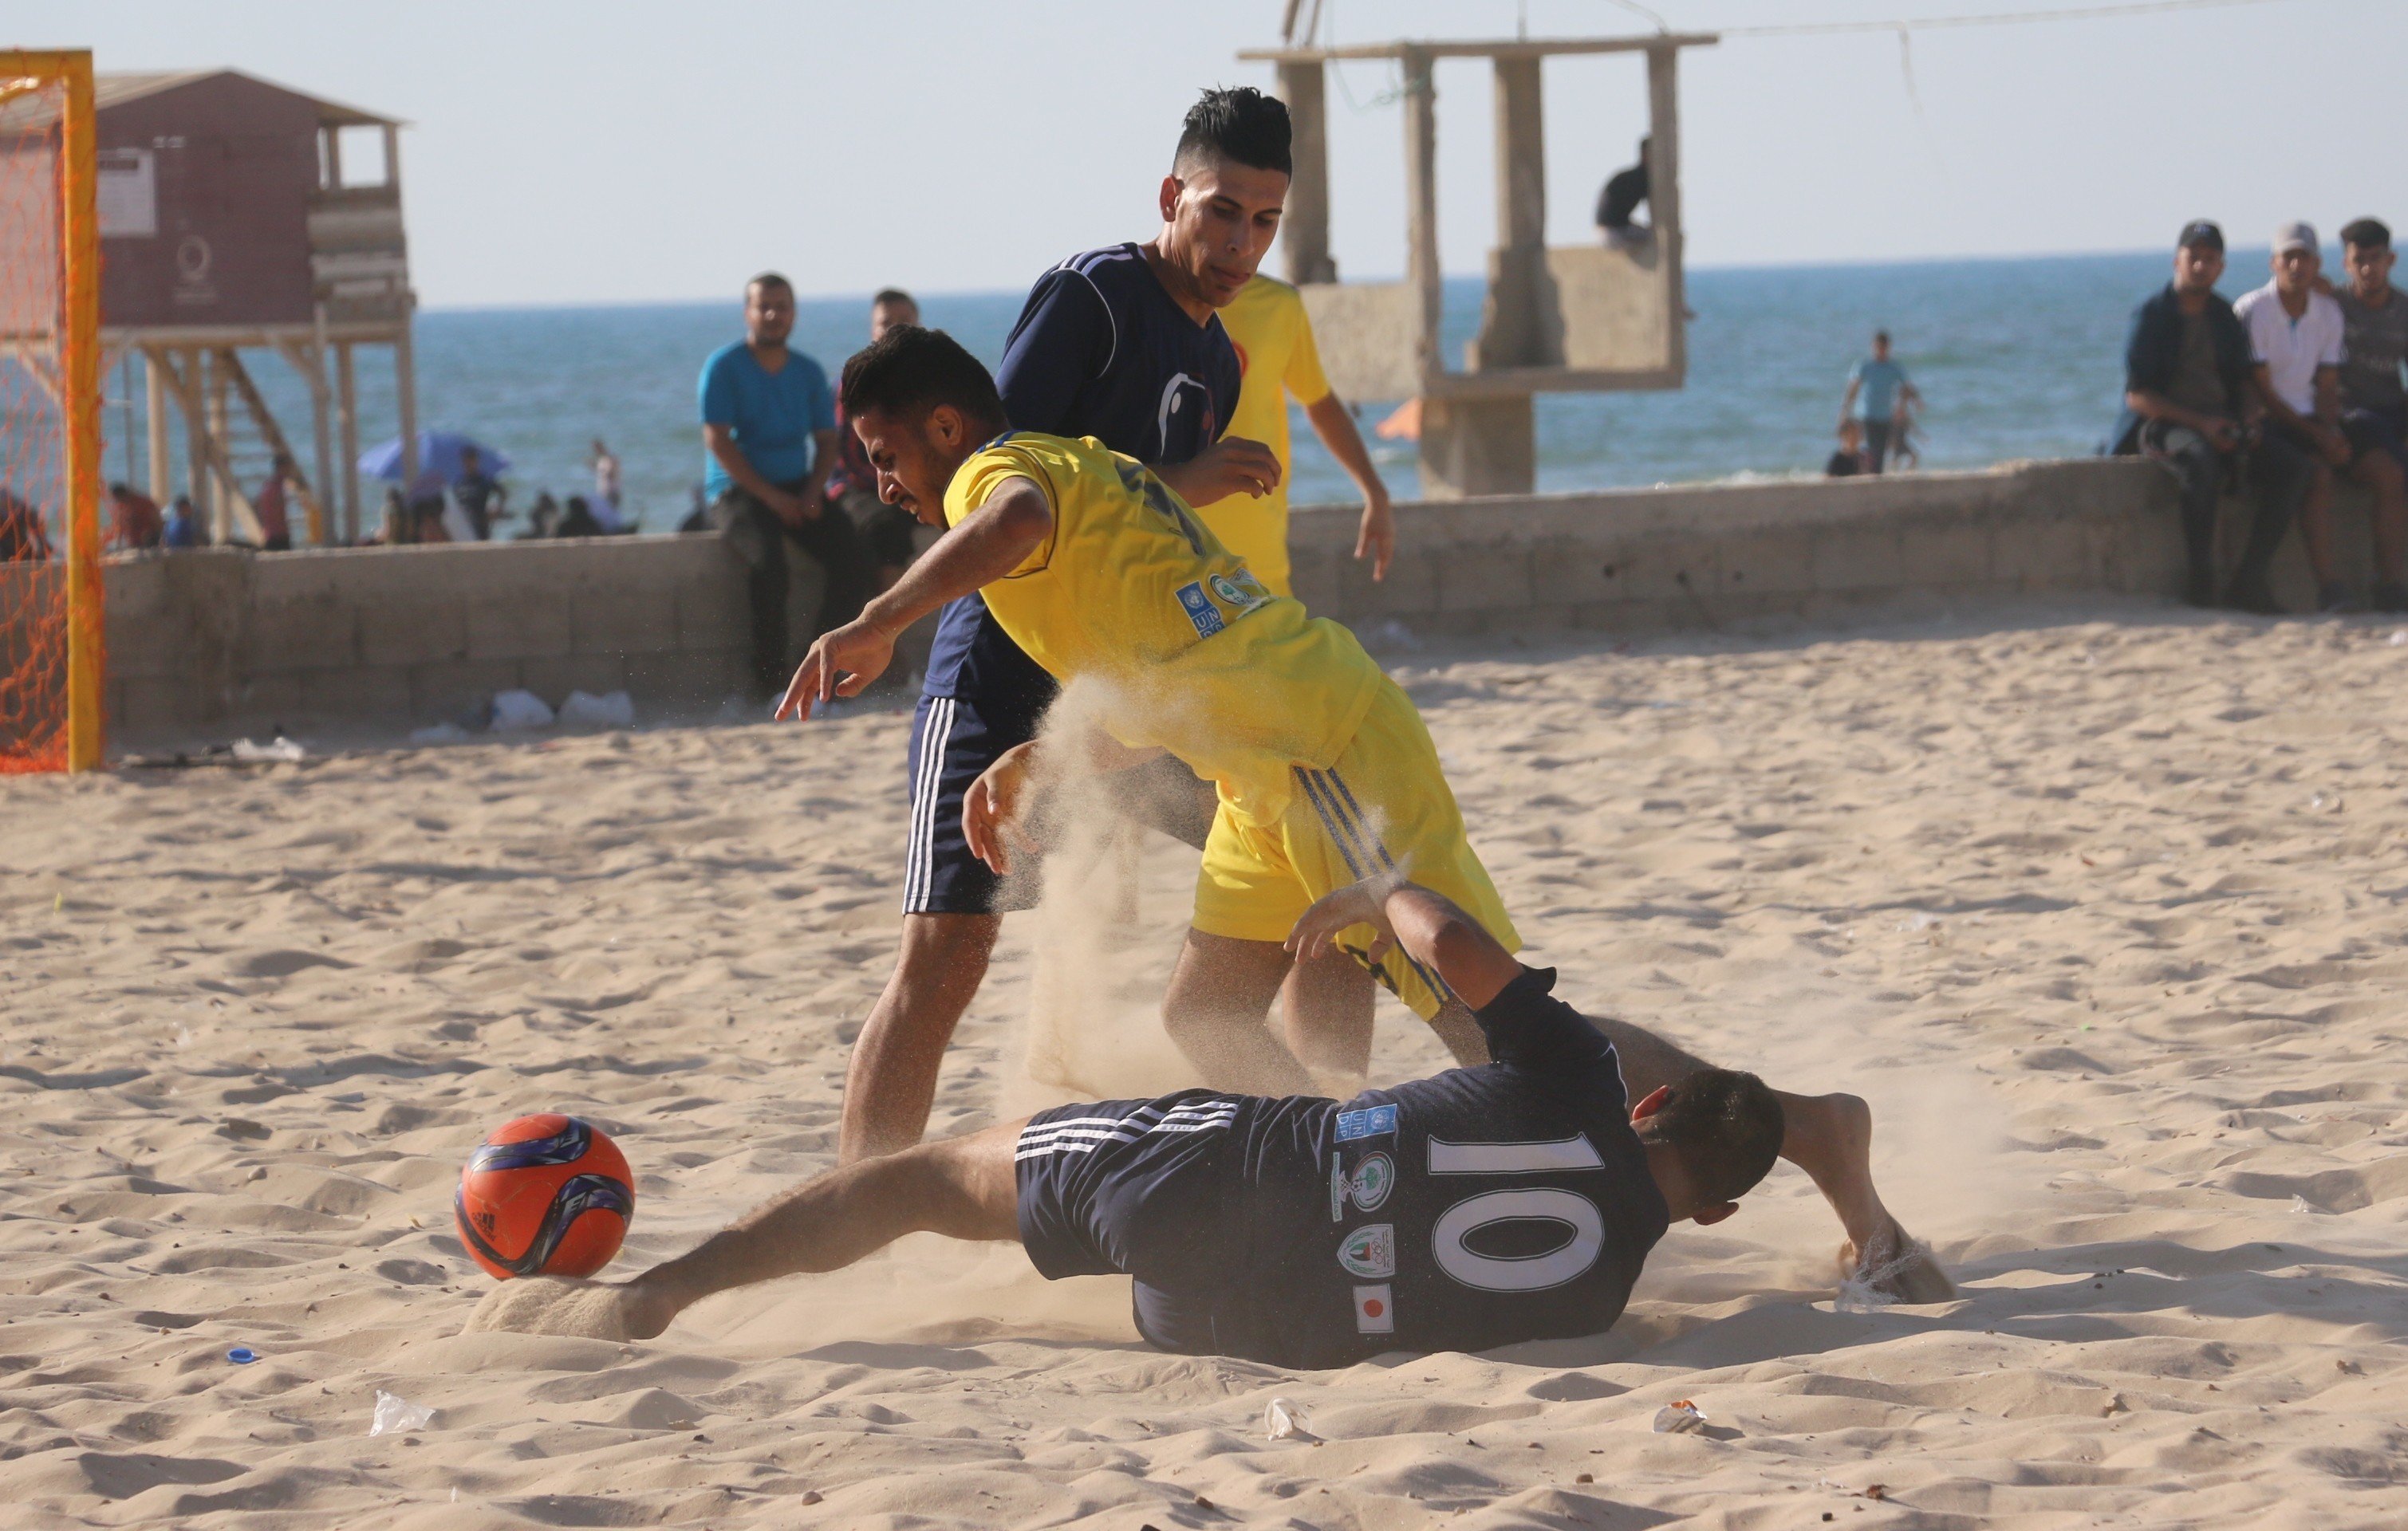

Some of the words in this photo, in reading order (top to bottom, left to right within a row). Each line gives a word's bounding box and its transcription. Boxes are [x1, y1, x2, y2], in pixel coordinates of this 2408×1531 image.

[1196, 611, 1220, 628] UN
[1338, 1116, 1350, 1137] DP
[1353, 1113, 1365, 1135] UN
[1428, 1131, 1605, 1293] 10
